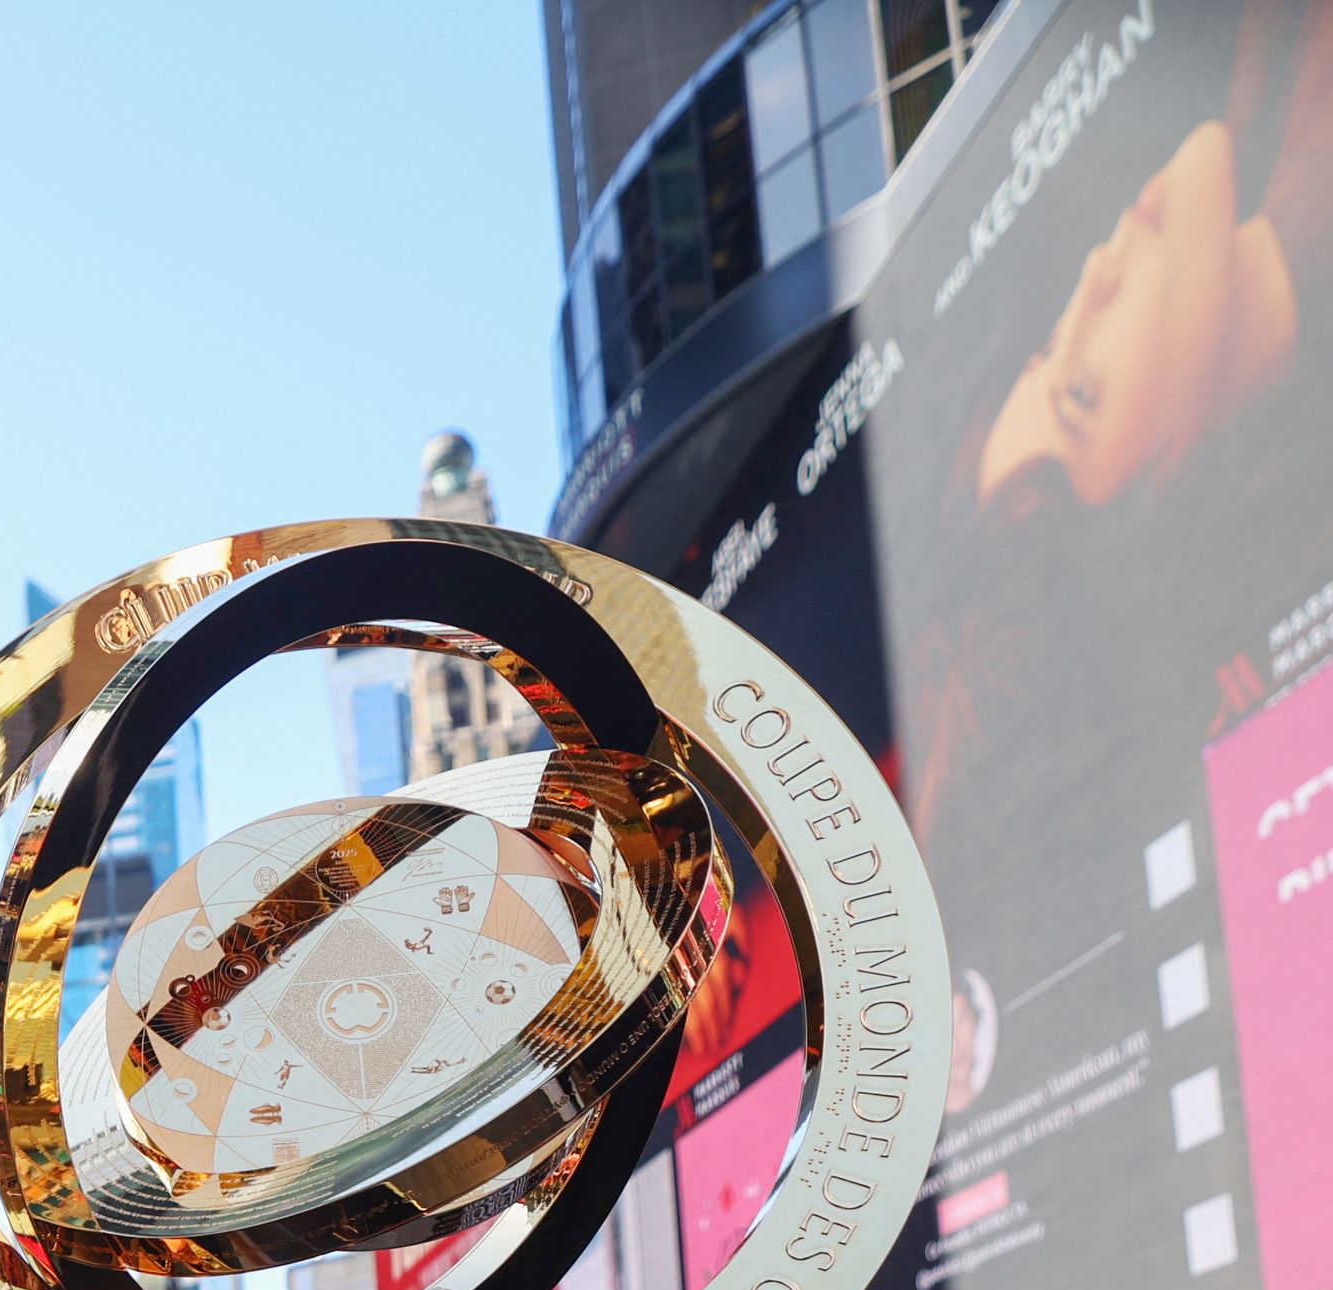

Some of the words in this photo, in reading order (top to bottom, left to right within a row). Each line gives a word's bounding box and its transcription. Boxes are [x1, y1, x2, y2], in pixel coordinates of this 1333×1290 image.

[969, 0, 1155, 263] KEOGHAN
[797, 337, 904, 496] ORTEGA
[712, 679, 862, 840] COUPE
[330, 848, 357, 859] 2025
[827, 843, 906, 929] DU
[630, 1020, 651, 1045] UNE
[836, 944, 913, 1160] MONDE
[785, 1167, 880, 1272] DES
